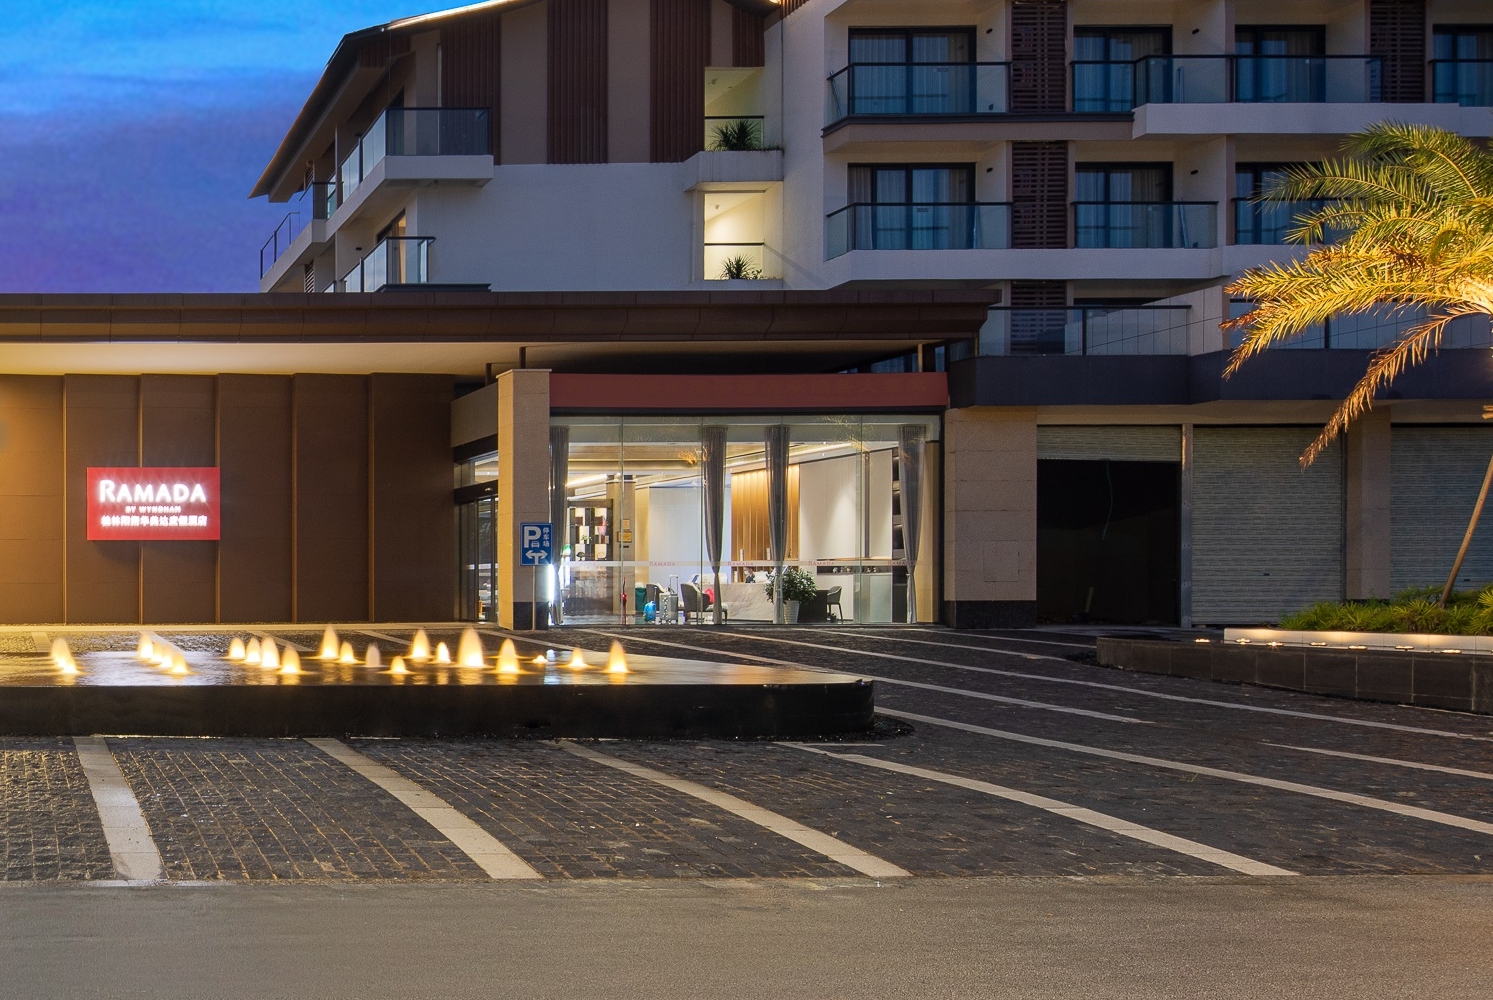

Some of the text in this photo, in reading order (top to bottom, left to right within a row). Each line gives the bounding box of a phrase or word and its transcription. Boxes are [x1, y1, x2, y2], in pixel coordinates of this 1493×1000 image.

[99, 480, 206, 503] RAMADA
[125, 505, 181, 513] BY WYNDHAM
[524, 526, 542, 548] P
[542, 526, 550, 548] 停车场
